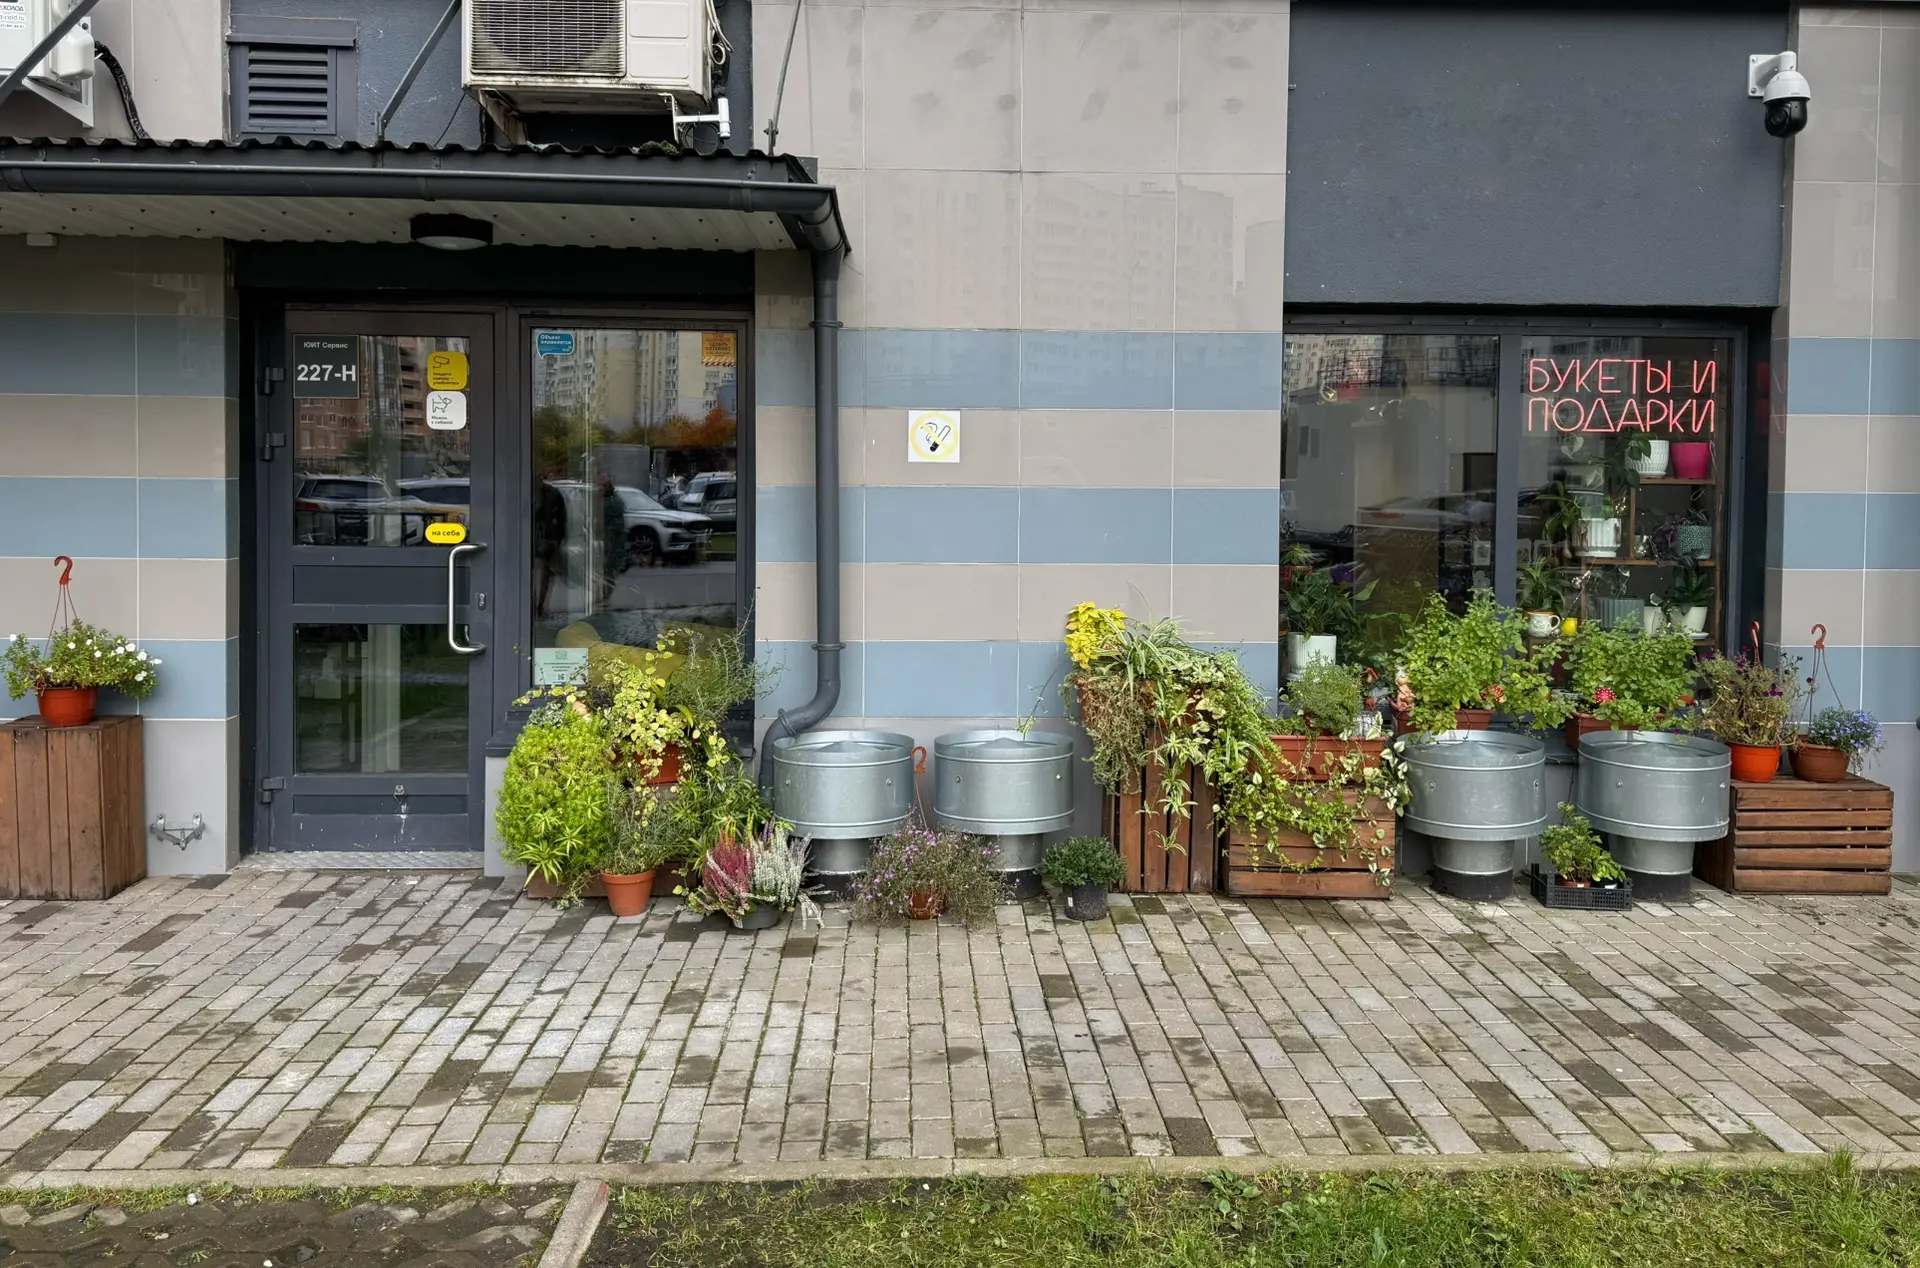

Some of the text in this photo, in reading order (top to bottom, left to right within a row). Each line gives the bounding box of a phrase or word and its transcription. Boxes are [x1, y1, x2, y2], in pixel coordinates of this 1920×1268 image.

[322, 341, 348, 349] Сервис
[297, 364, 356, 381] 227-Н
[1528, 358, 1716, 394] БУКЕТЫ И
[1528, 397, 1715, 433] ПОДАРКИ
